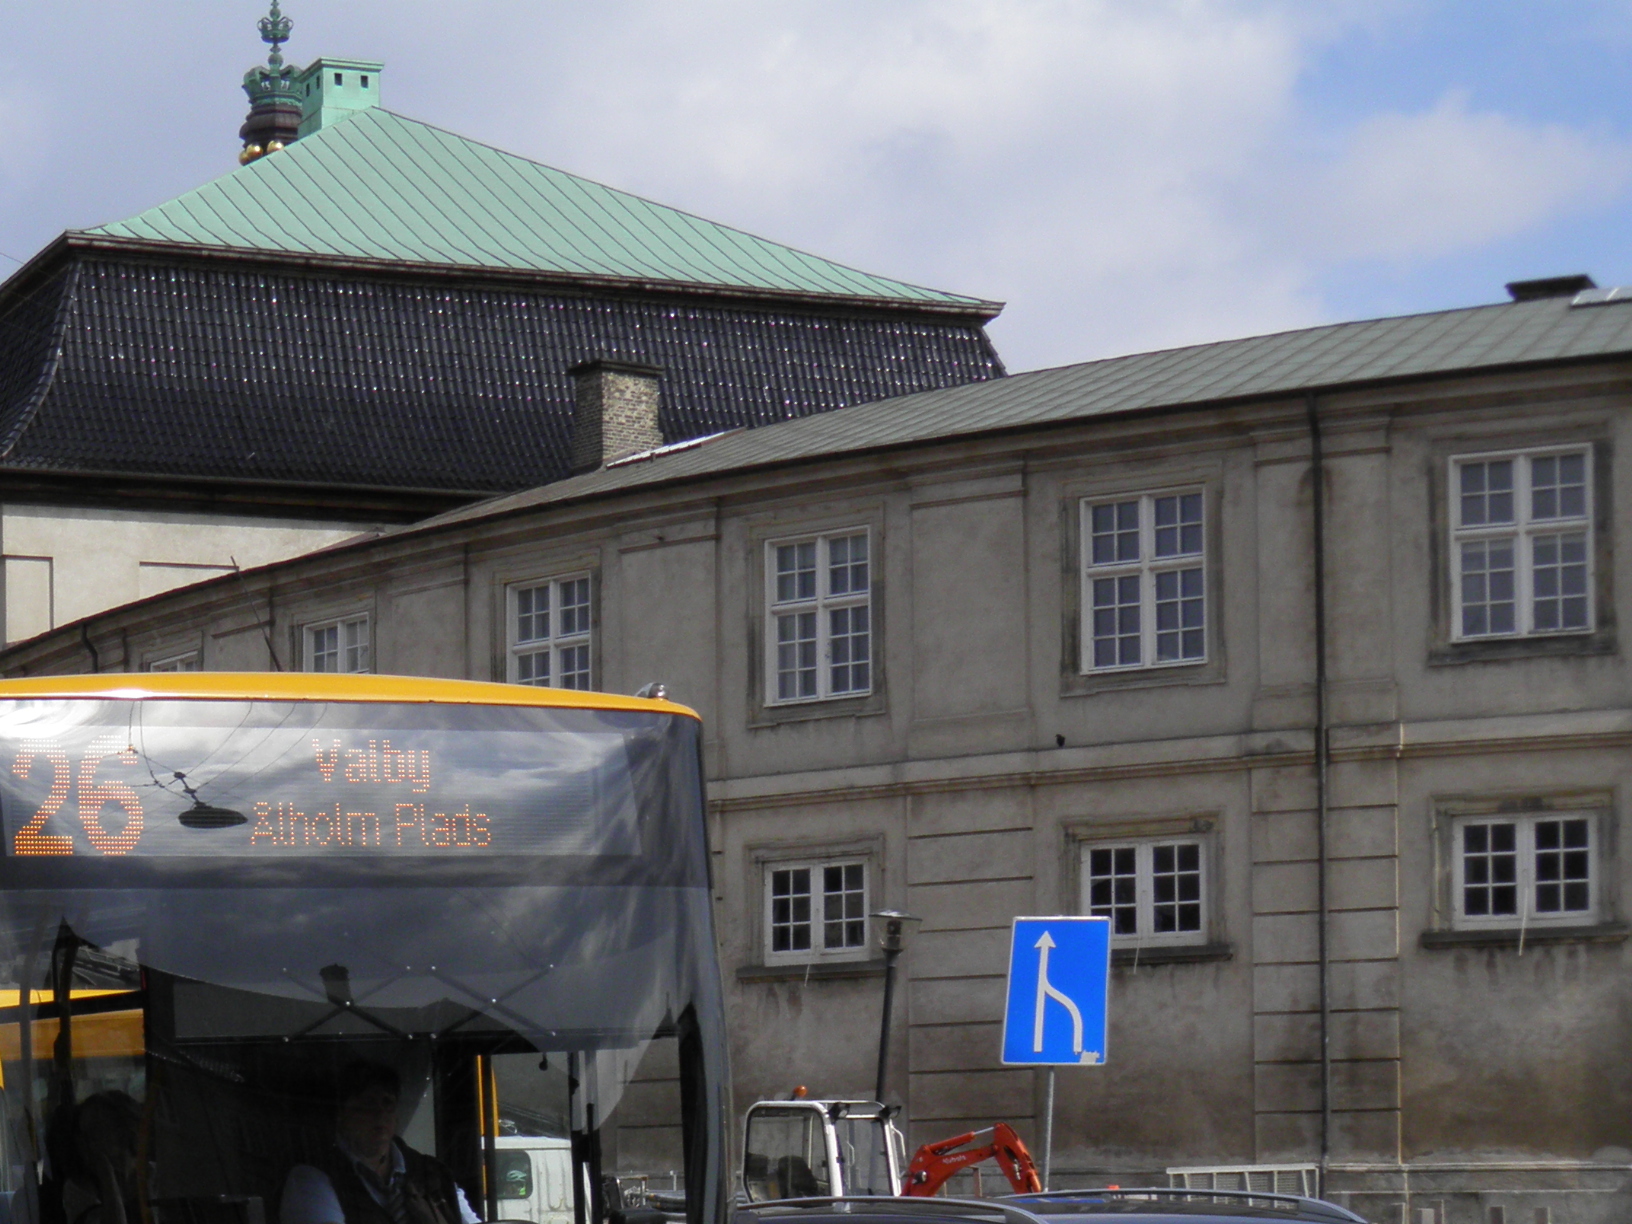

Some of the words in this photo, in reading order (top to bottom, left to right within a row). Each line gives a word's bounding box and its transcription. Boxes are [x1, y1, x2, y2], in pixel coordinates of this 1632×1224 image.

[311, 738, 431, 793] Valby
[12, 734, 144, 856] 26
[396, 802, 491, 847] Plads
